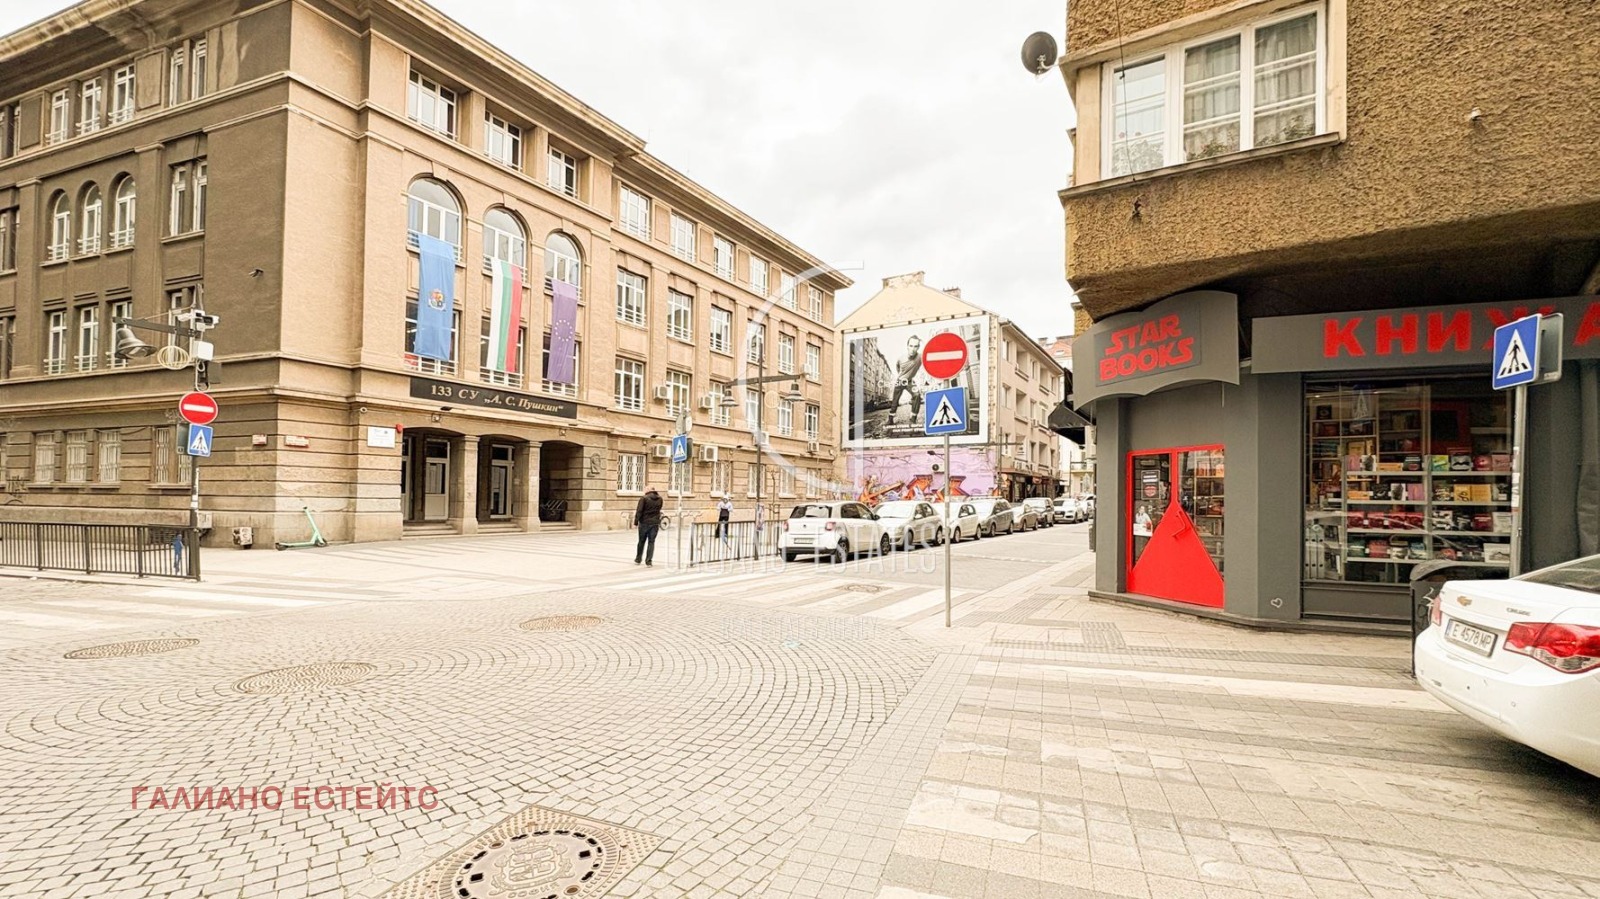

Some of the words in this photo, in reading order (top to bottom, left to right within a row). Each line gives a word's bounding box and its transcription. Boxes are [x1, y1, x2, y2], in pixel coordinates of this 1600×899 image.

[1105, 313, 1182, 355] STAR
[1099, 337, 1194, 381] BOOKS
[430, 384, 452, 397] 133
[1452, 623, 1460, 638] E
[1461, 625, 1480, 645] 4578
